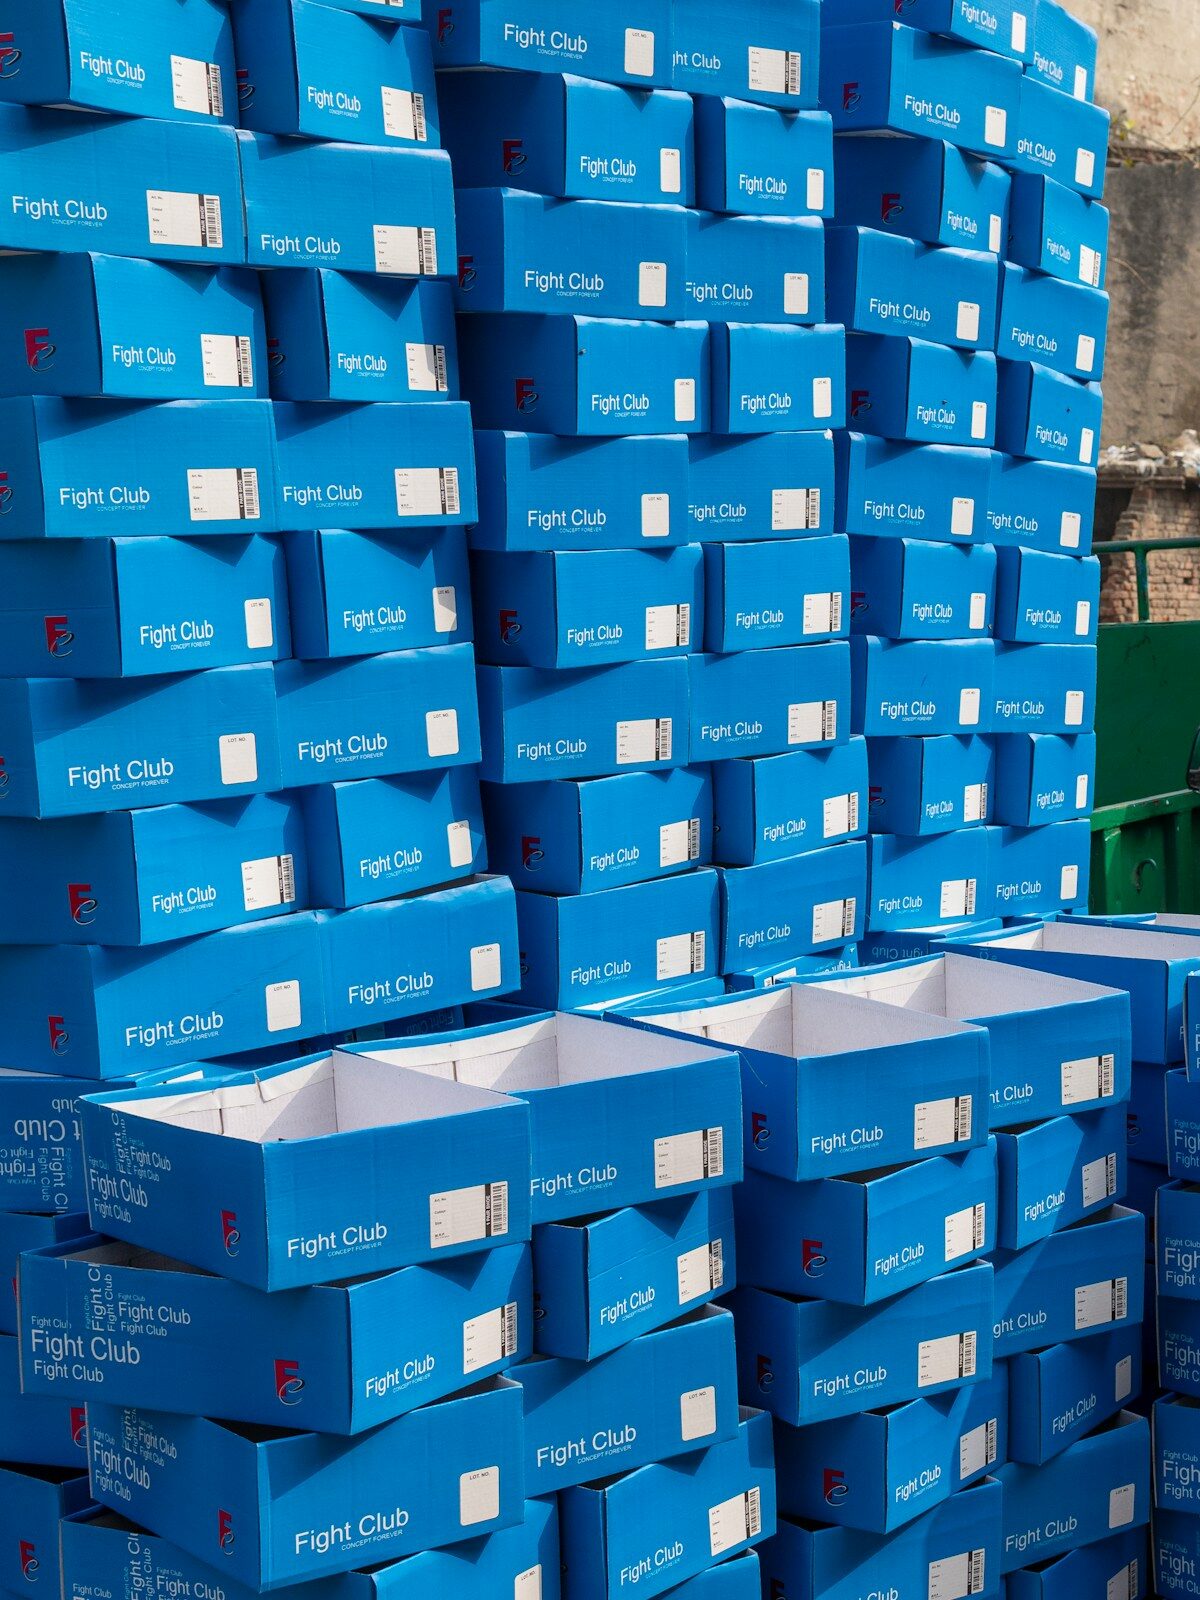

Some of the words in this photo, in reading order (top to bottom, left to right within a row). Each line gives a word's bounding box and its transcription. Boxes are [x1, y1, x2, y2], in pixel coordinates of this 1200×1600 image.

[961, 1, 980, 23] Fight
[980, 10, 998, 30] Club
[504, 23, 545, 48] Fight
[550, 31, 588, 53] Club
[80, 51, 113, 77] Fight
[115, 59, 146, 82] Club
[538, 49, 560, 58] CONCEPT
[561, 51, 582, 60] FOREVER
[905, 94, 933, 116] Fight
[935, 104, 960, 124] Club
[12, 196, 60, 220] Fight
[64, 200, 108, 220] Club
[525, 270, 564, 292] Fight
[568, 272, 604, 290] Club
[870, 298, 900, 318] Fight
[903, 304, 931, 322] Club
[112, 345, 144, 368] Fight
[146, 347, 176, 365] Club
[916, 406, 937, 424] Fight
[938, 408, 956, 424] Club
[60, 488, 104, 509] Fight
[110, 486, 150, 504] Club
[343, 609, 375, 632] Fight
[377, 606, 406, 625] Club
[140, 624, 177, 648] Fight
[180, 620, 214, 640] Club
[170, 642, 190, 650] CONCEPT
[567, 628, 594, 646] Fight
[597, 624, 623, 640] Club
[880, 702, 908, 720] Fight
[911, 701, 936, 716] Club
[298, 739, 343, 762] Fight
[348, 733, 388, 754] Club
[335, 755, 359, 764] CONCEPT
[360, 752, 384, 760] FOREVER
[517, 742, 552, 760] Fight
[555, 738, 587, 754] Club
[68, 764, 121, 789] Fight
[127, 758, 174, 780] Club
[112, 781, 140, 790] CONCEPT
[141, 778, 170, 788] FOREVER
[590, 852, 614, 872] Fight
[616, 846, 640, 863] Club
[348, 980, 391, 1004] Fight
[396, 972, 433, 994] Club
[384, 995, 406, 1004] CONCEPT
[407, 990, 430, 999] FOREVER
[126, 1020, 174, 1047] Fight
[180, 1011, 224, 1034] Club
[166, 1036, 192, 1046] CONCEPT
[193, 1031, 220, 1041] FOREVER
[14, 1119, 66, 1142] Club
[812, 1132, 846, 1154] Fight
[850, 1126, 883, 1144] Club
[51, 1147, 65, 1188] Fight
[130, 1145, 151, 1165] Fight
[152, 1152, 171, 1171] Club
[90, 1169, 119, 1202] Fight
[120, 1179, 148, 1208] Club
[530, 1172, 573, 1196] Fight
[578, 1164, 617, 1185] Club
[288, 1232, 337, 1258] Fight
[342, 1222, 387, 1245] Club
[875, 1252, 899, 1276] Fight
[901, 1242, 924, 1263] Club
[104, 1273, 114, 1300] Club
[90, 1288, 106, 1331] Fight
[118, 1301, 154, 1323] Fight
[158, 1306, 191, 1325] Club
[121, 1321, 144, 1335] Fight
[146, 1325, 167, 1336] Club
[31, 1328, 84, 1361] Fight
[90, 1336, 140, 1364] Club
[1165, 1341, 1200, 1366] Fight
[34, 1360, 68, 1380] Fight
[72, 1364, 104, 1383] Club
[366, 1368, 400, 1398] Fight
[403, 1354, 435, 1380] Club
[814, 1374, 850, 1396] Fight
[854, 1366, 887, 1386] Club
[537, 1438, 586, 1467] Fight
[592, 1424, 636, 1451] Club
[577, 1452, 604, 1464] CONCEPT
[605, 1445, 632, 1456] FOREVER
[93, 1440, 122, 1476] Fight
[124, 1456, 150, 1490] Club
[295, 1522, 352, 1554] Fight
[358, 1508, 409, 1536] Club
[341, 1536, 371, 1550] CONCEPT
[372, 1529, 403, 1542] FOREVER
[1006, 1528, 1040, 1552] Fight
[1045, 1516, 1078, 1538] Club
[620, 1556, 652, 1586] Fight
[654, 1541, 683, 1566] Club
[1160, 1549, 1195, 1575] Fight
